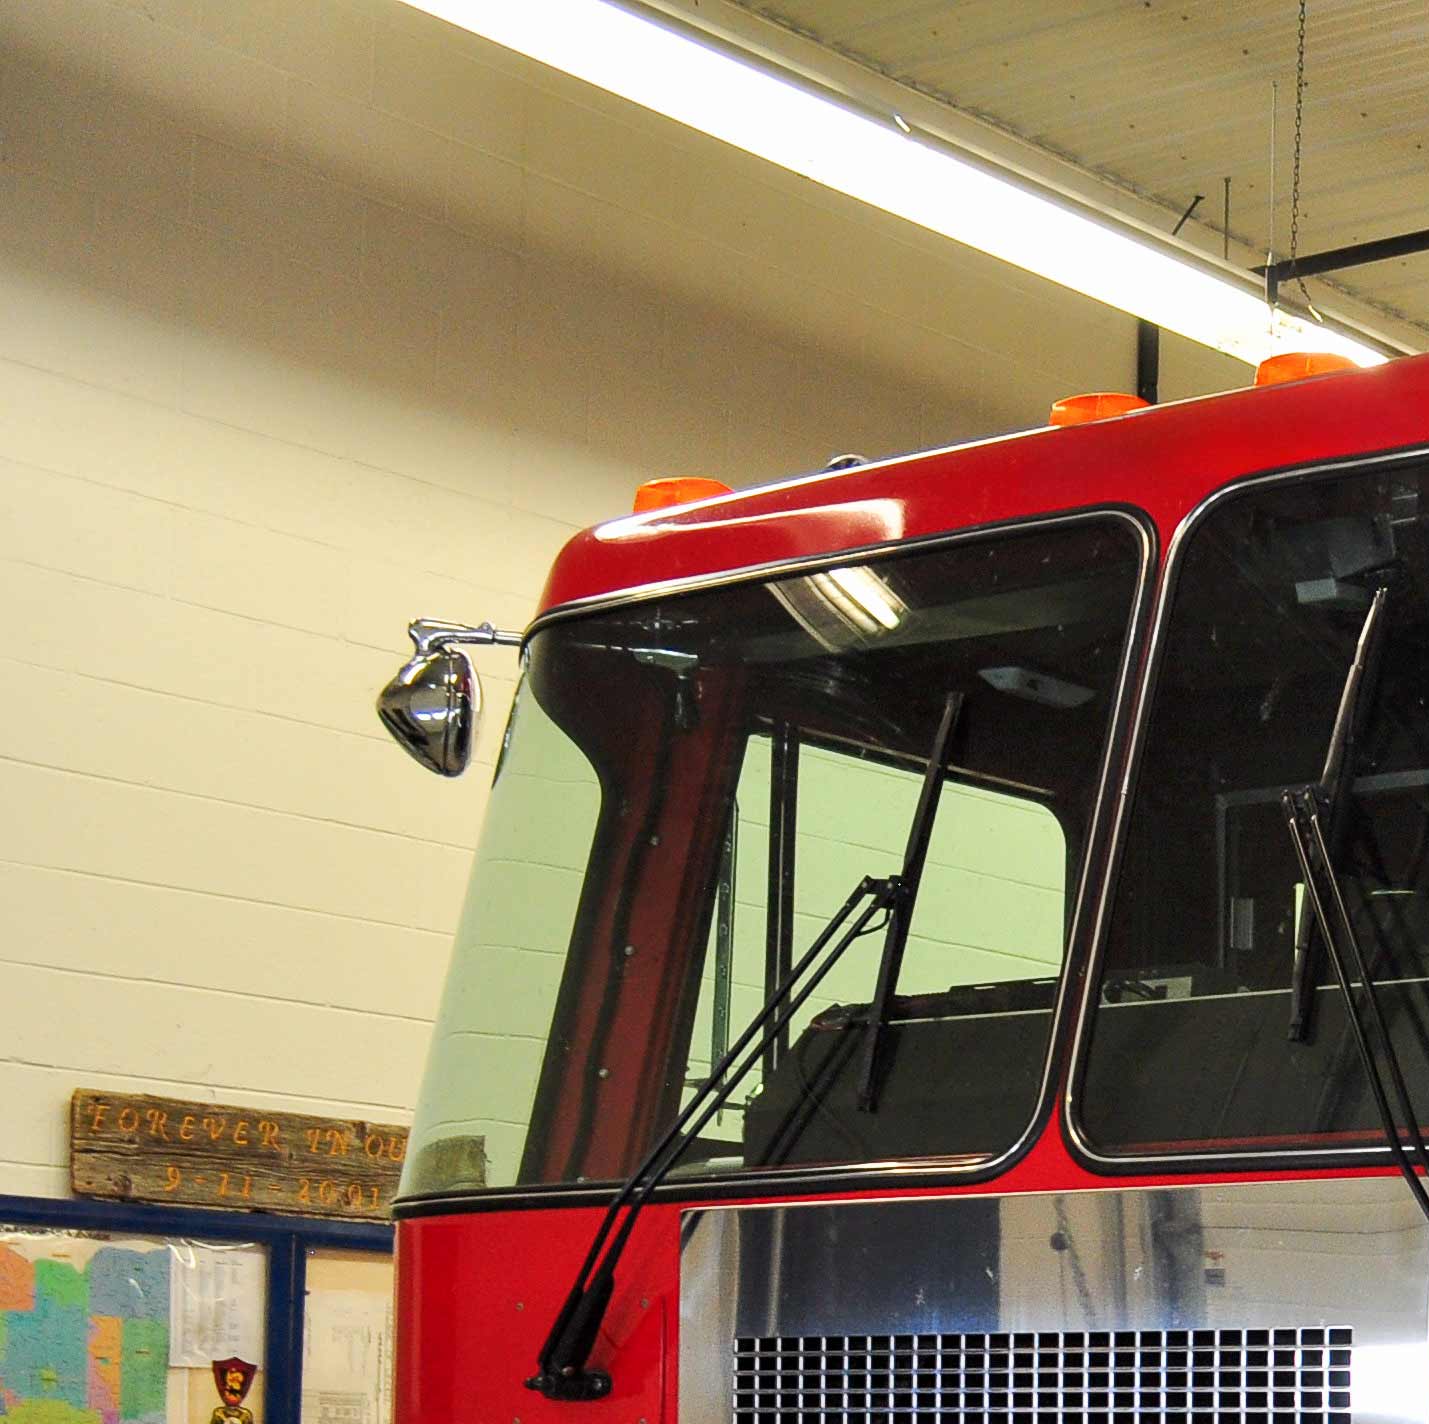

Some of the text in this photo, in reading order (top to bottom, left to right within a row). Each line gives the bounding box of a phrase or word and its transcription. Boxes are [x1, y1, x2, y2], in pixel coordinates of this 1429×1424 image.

[87, 1102, 408, 1162] FOREVER IN OU
